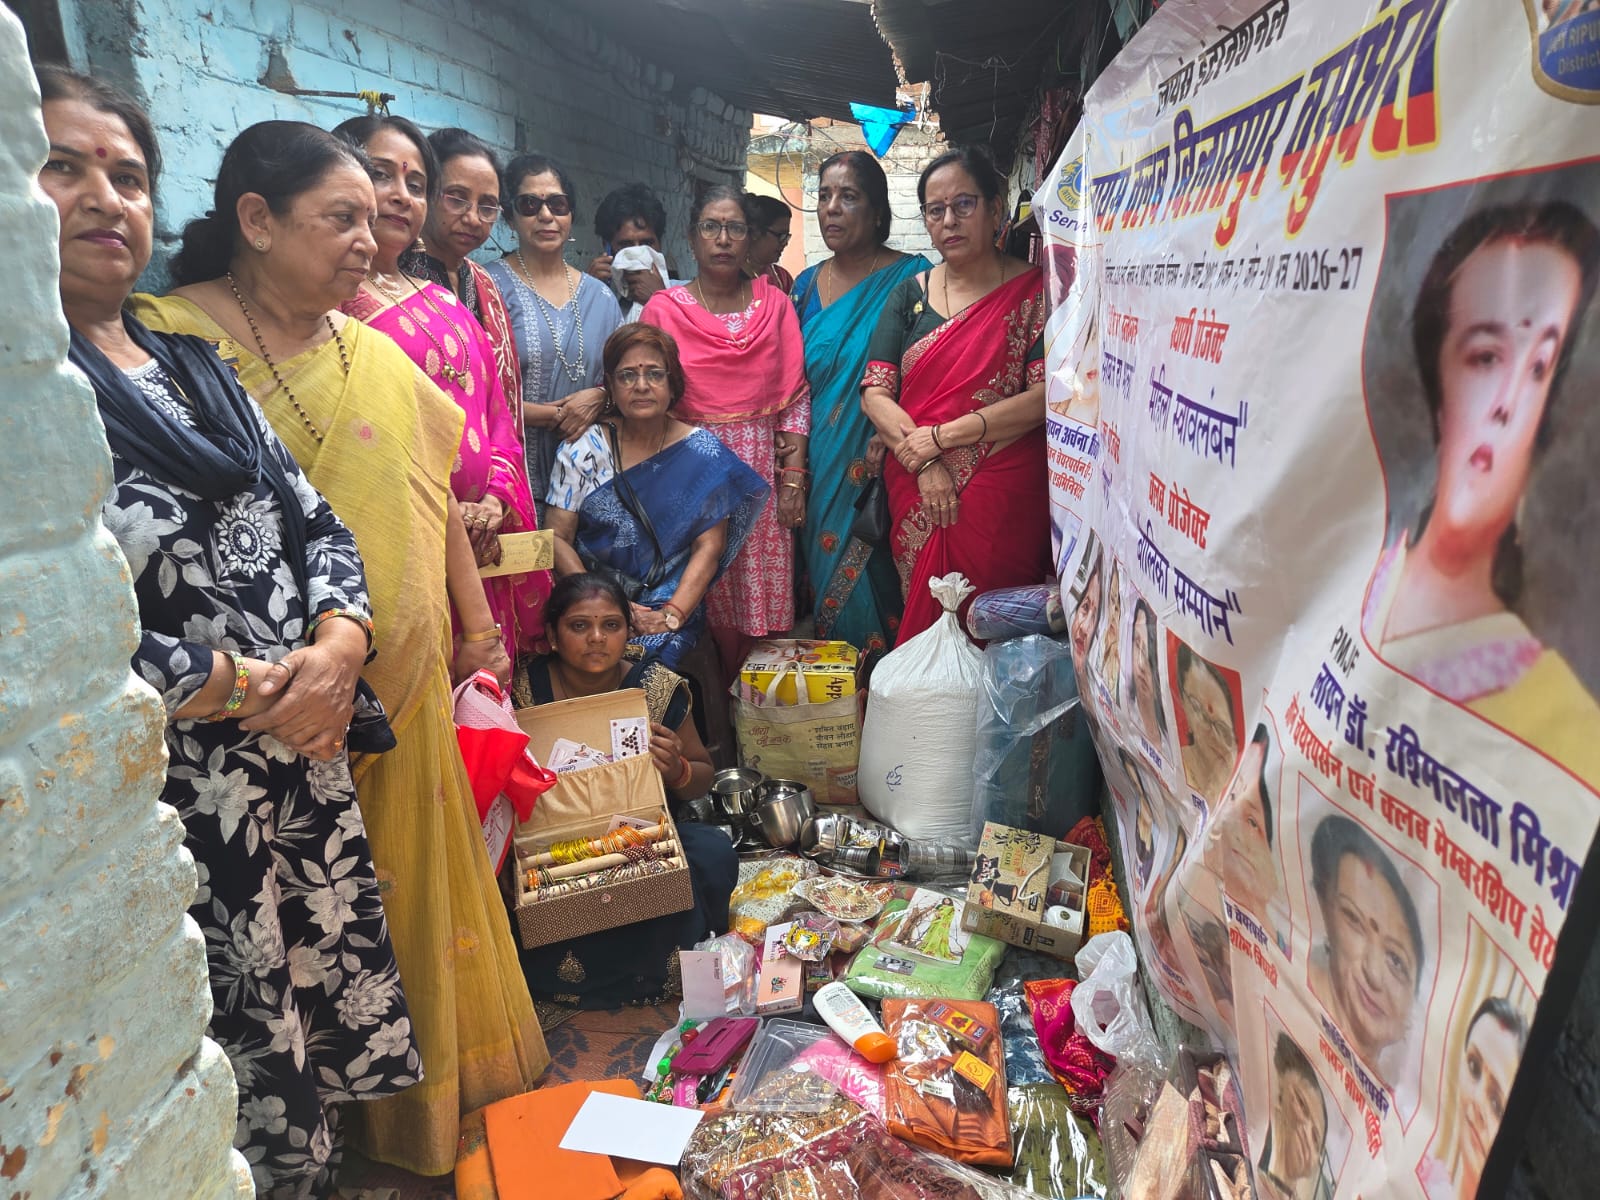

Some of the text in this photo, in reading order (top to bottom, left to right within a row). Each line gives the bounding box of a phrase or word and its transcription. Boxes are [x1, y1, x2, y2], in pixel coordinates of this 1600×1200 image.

[1162, 74, 1305, 247] बिलासपुर
[1292, 247, 1363, 291] 2026-27
[1167, 481, 1211, 550] प्रोजेक्ट
[1330, 624, 1360, 679] PMJF
[1310, 661, 1346, 732] लायन
[1346, 765, 1376, 811] एवं
[1378, 788, 1431, 851] क्लब
